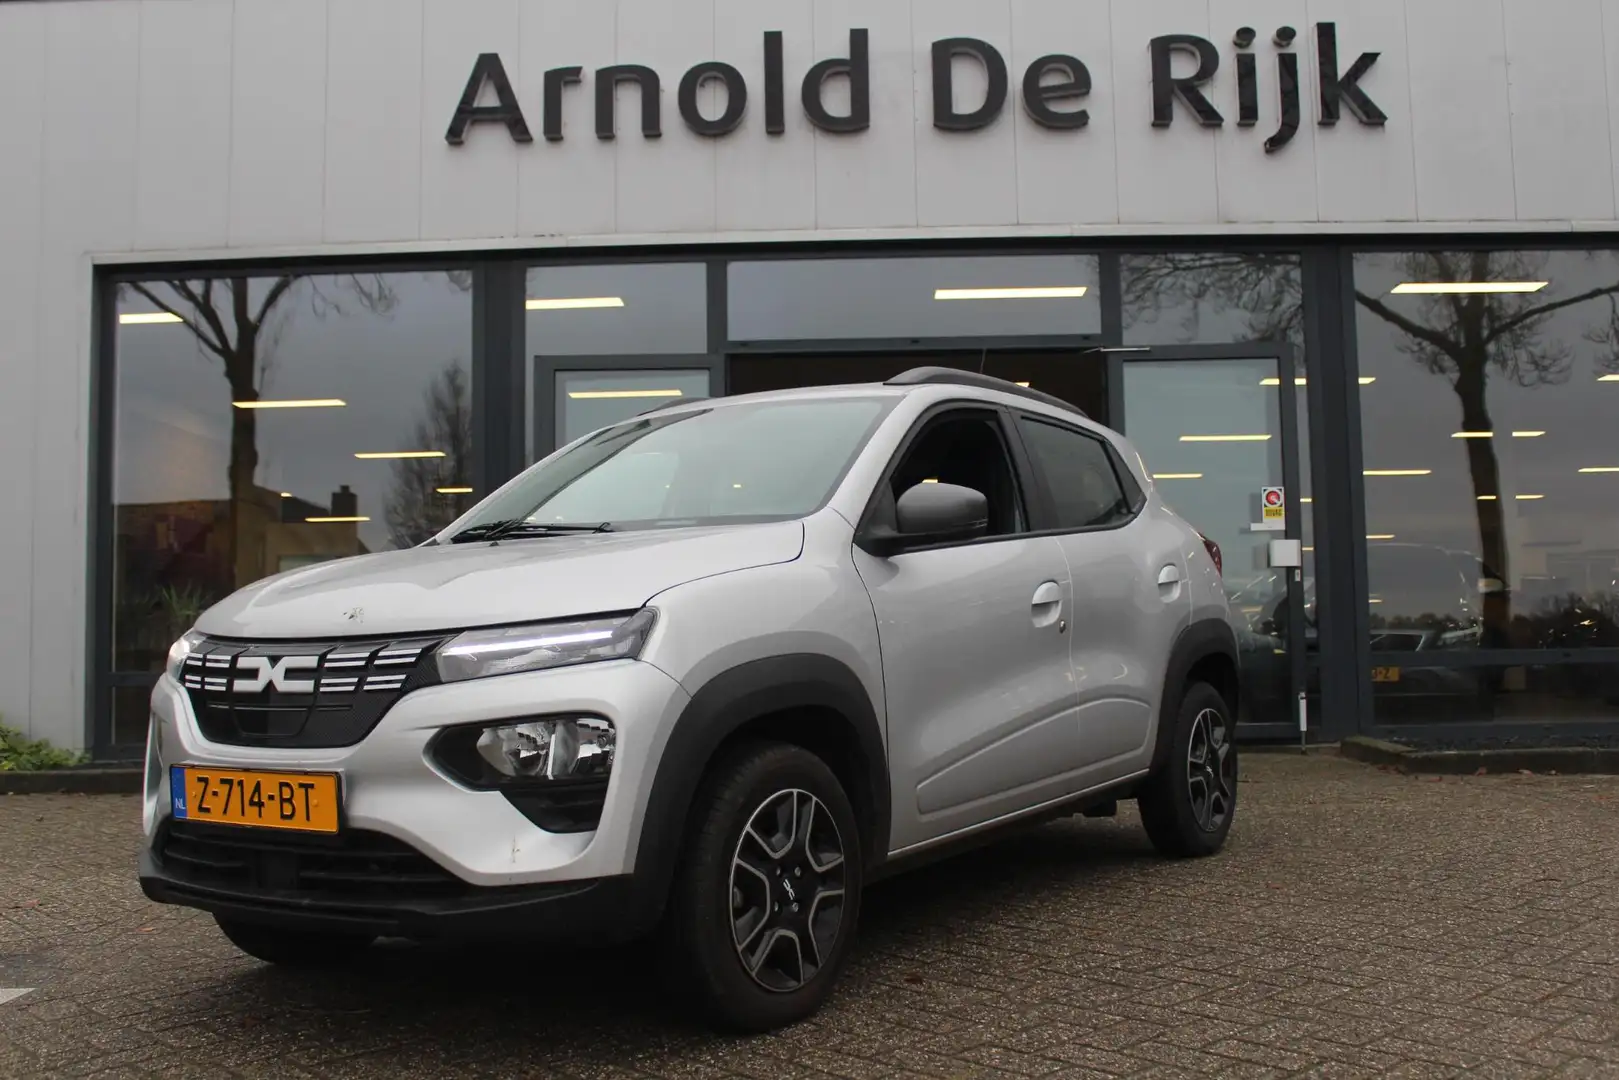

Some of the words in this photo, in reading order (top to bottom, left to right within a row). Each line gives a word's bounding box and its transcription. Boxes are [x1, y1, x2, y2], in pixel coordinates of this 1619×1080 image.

[445, 28, 870, 145] Arnold
[931, 37, 1092, 130] De
[1149, 22, 1388, 153] Rijk
[175, 798, 186, 810] NL
[196, 776, 315, 822] Z-714-BT
